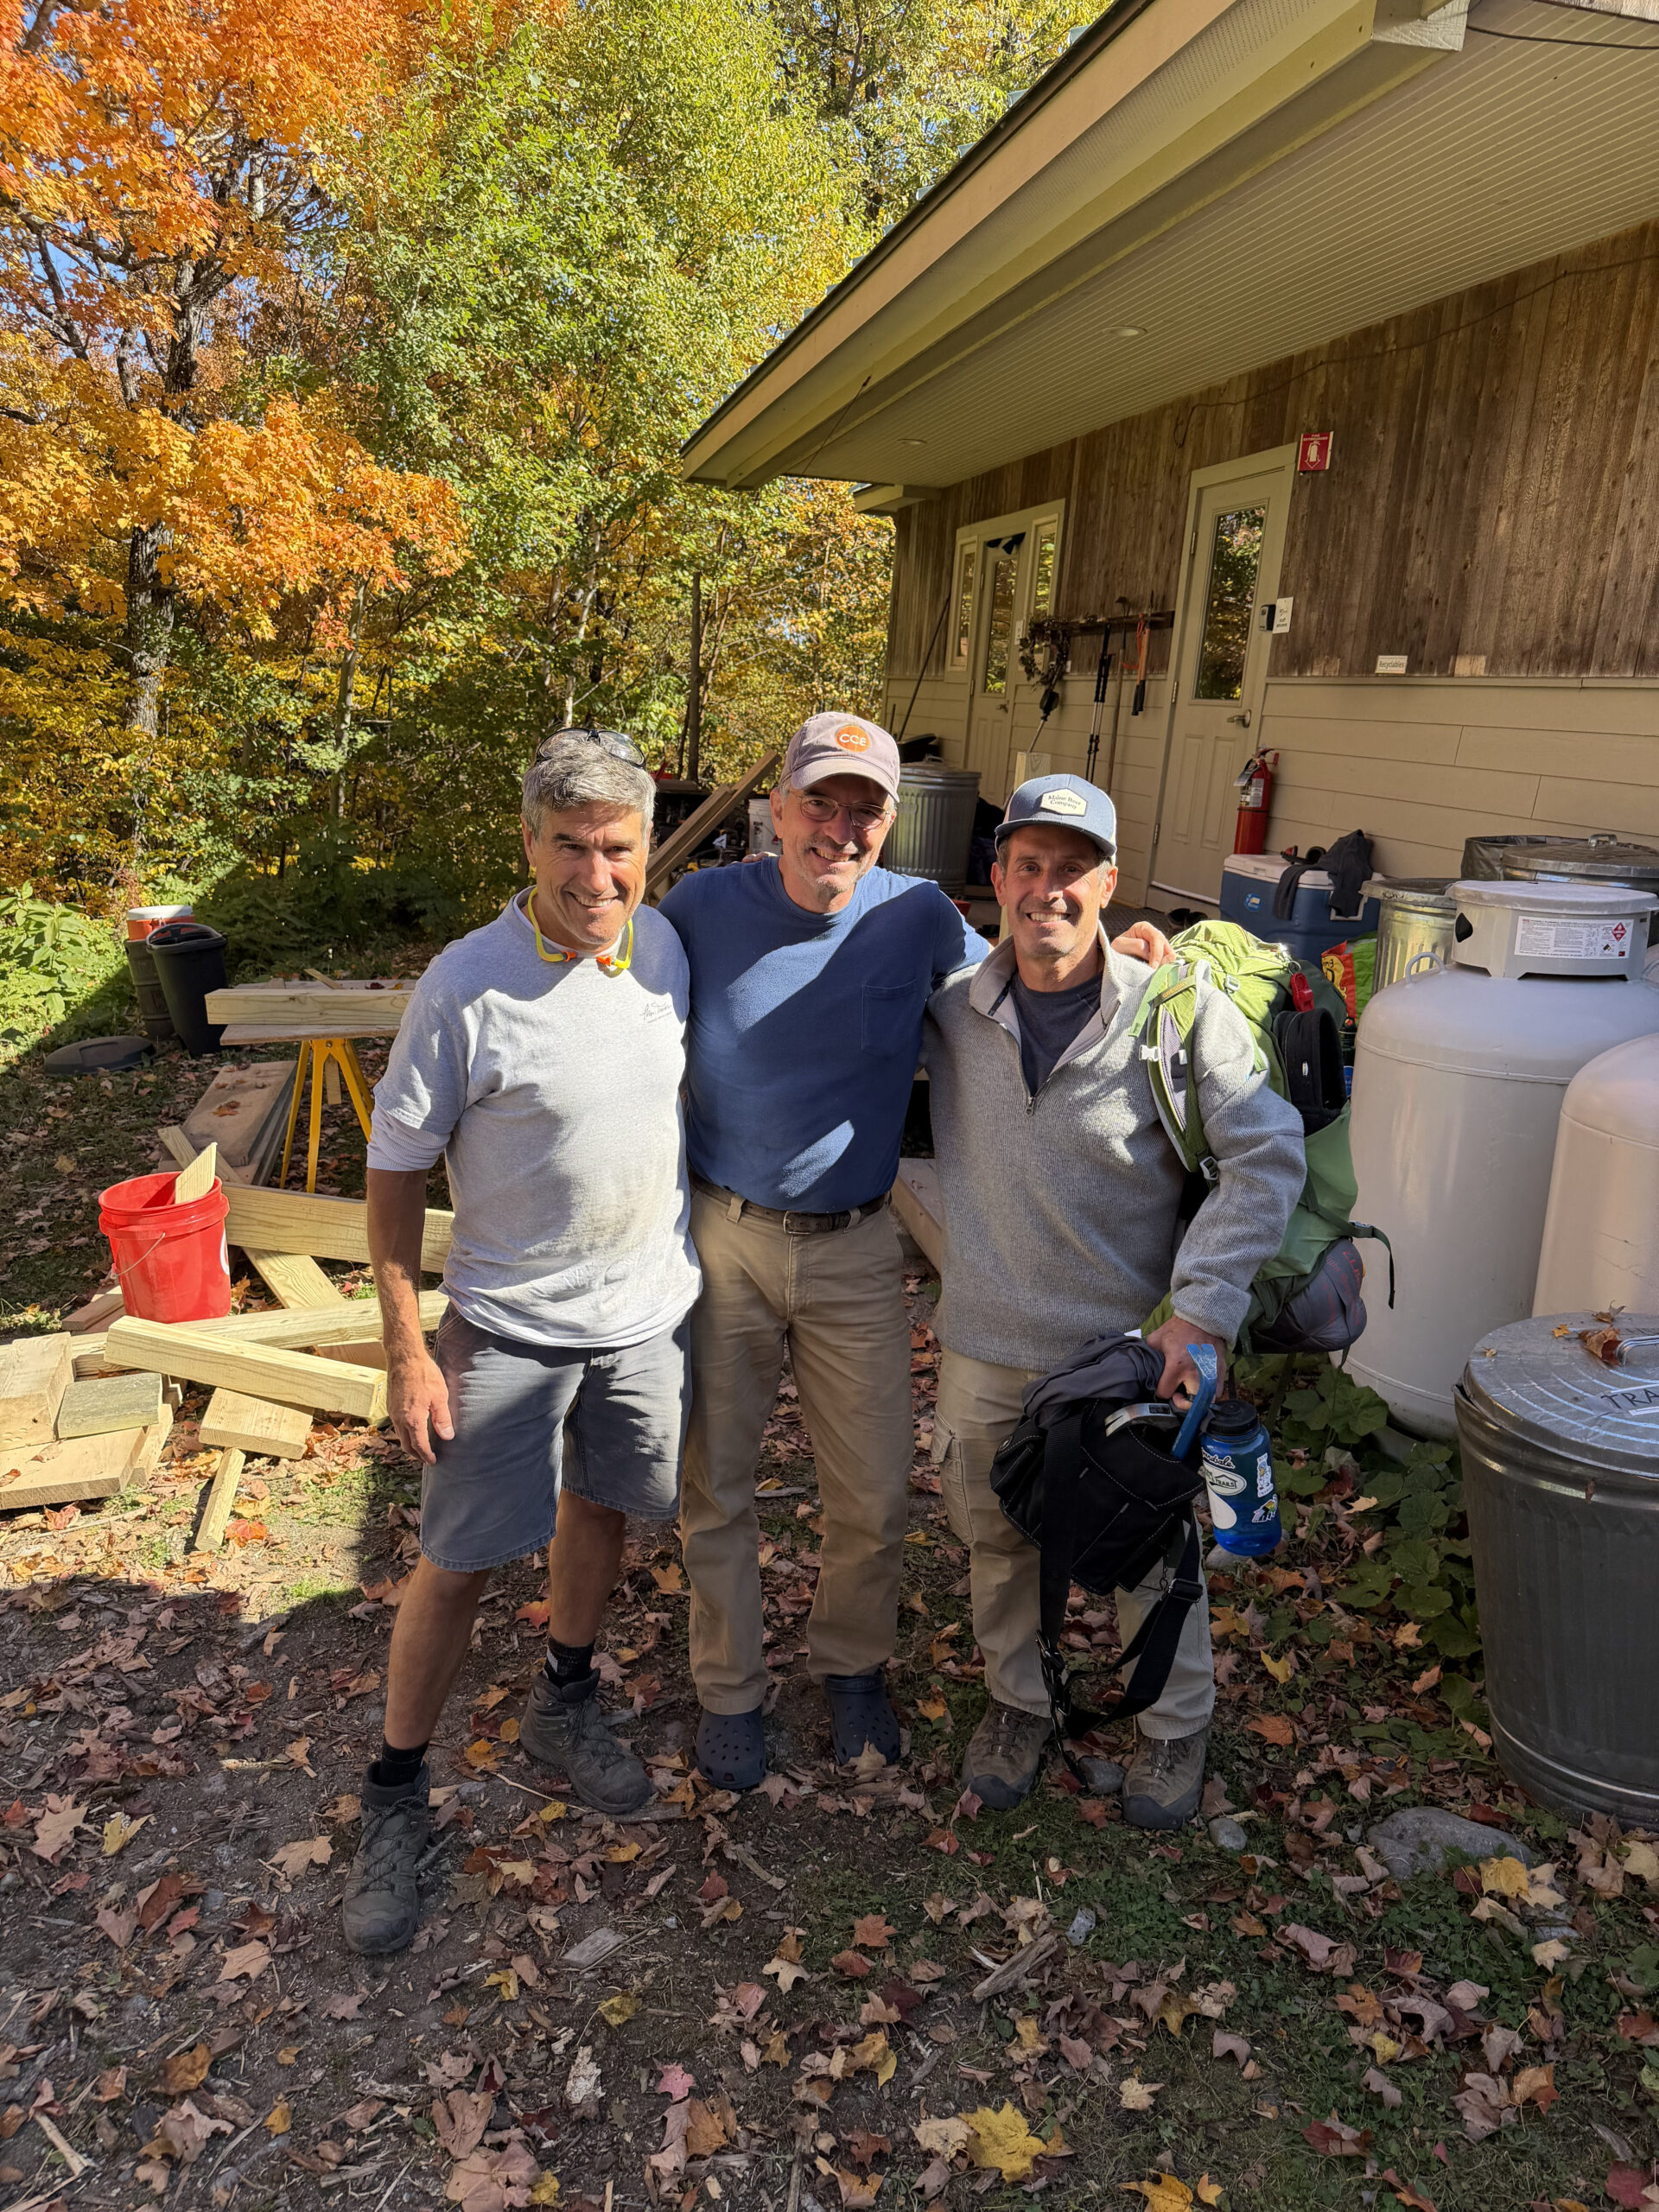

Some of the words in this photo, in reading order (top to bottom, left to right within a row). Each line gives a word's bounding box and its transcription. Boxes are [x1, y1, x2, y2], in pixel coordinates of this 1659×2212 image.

[1379, 659, 1404, 670] Recyclables
[839, 734, 867, 747] CCE
[1050, 800, 1077, 809] Company
[1162, 981, 1187, 998] GREGORY
[1216, 1478, 1235, 1488] TRAILS
